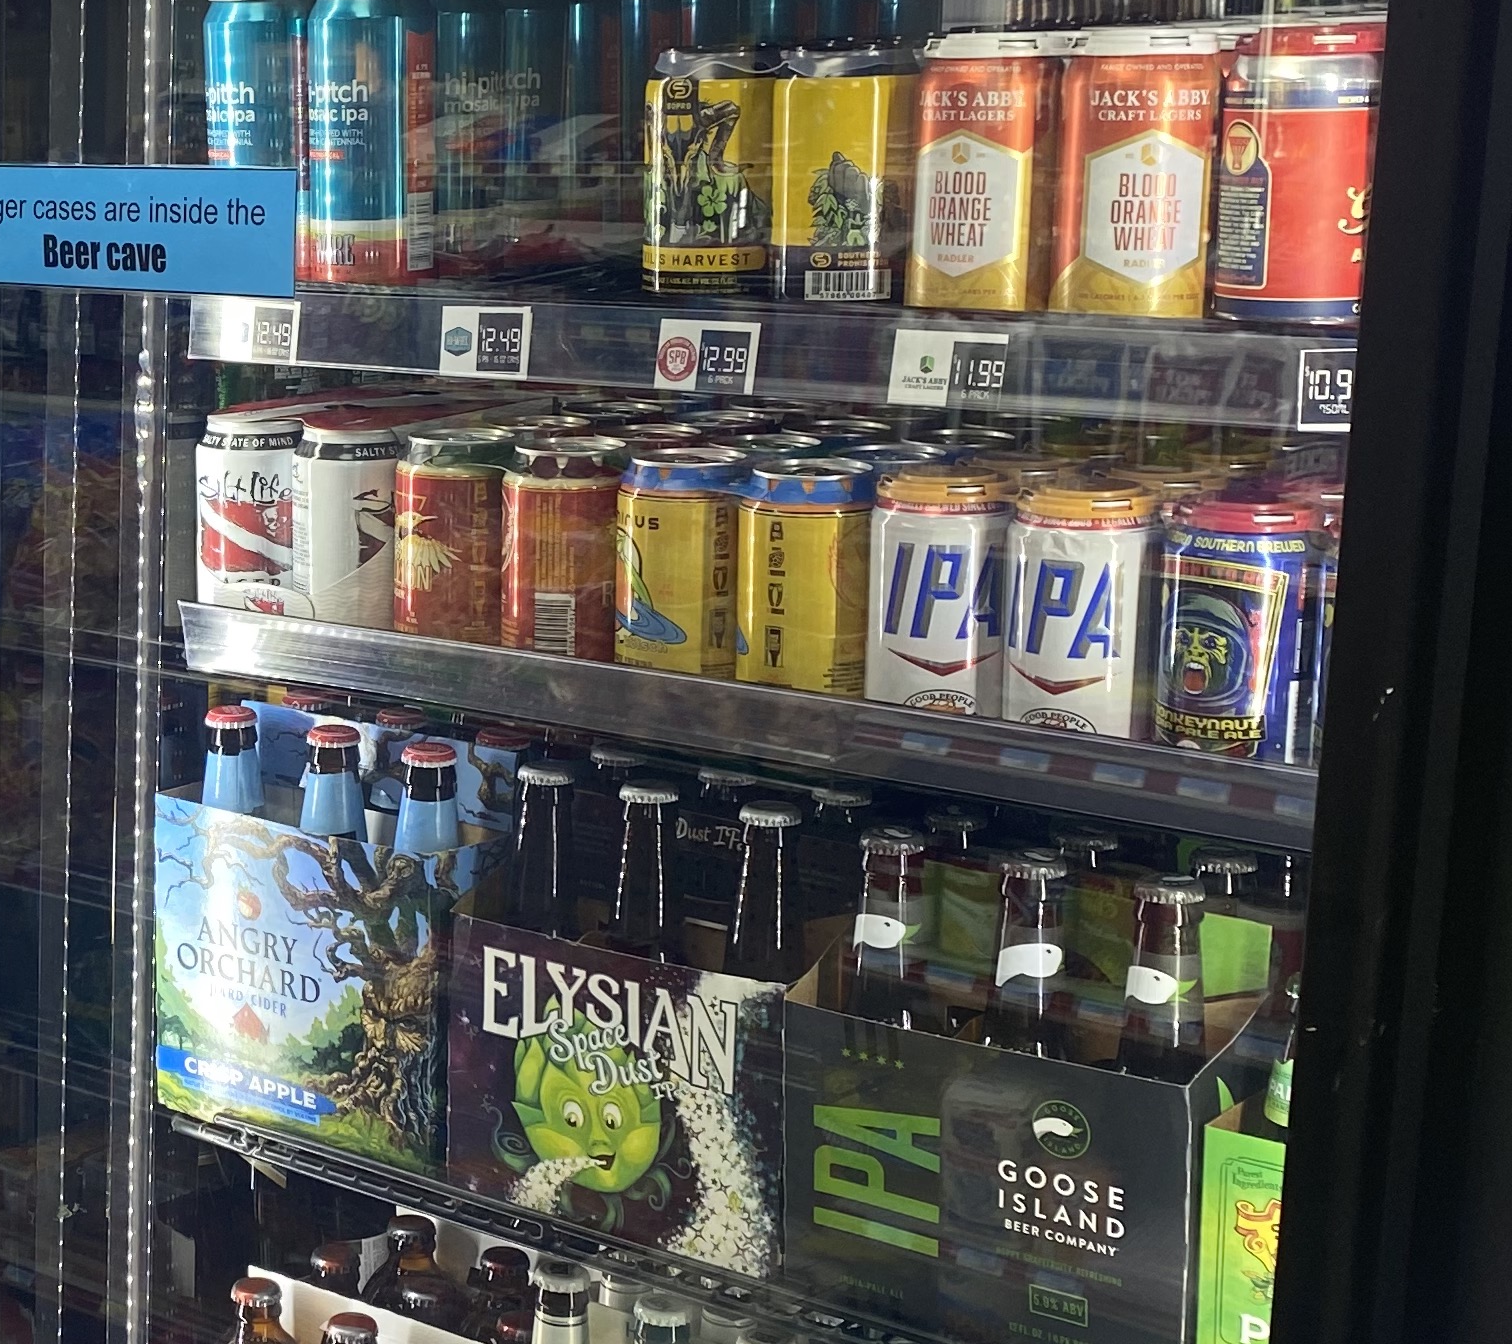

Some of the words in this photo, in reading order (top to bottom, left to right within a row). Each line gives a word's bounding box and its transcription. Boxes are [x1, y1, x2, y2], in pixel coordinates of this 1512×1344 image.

[1090, 89, 1158, 109] JACK'S
[959, 109, 1016, 122] LAGERS
[1098, 109, 1151, 123] CRAFT
[934, 170, 987, 195] BLOOD
[1118, 172, 1178, 198] BLOOD
[33, 198, 97, 223] cases
[104, 201, 141, 223] are
[148, 195, 219, 226] inside
[226, 197, 267, 226] the
[929, 196, 992, 222] ORANGE
[1110, 199, 1182, 225] ORANGE
[930, 222, 989, 249] WHEAT
[1113, 225, 1178, 253] WHEAT
[43, 233, 100, 272] Beer
[106, 239, 167, 274] cave
[672, 252, 752, 267] HARVEST
[668, 349, 688, 365] SPB
[253, 437, 265, 448] OF
[268, 436, 294, 447] MIND
[354, 447, 386, 458] SALTY
[1193, 536, 1255, 554] SOUTHERN
[884, 542, 1002, 640] IPA
[1008, 558, 1126, 660] IPA
[938, 692, 976, 709] PEOPLE
[1052, 711, 1089, 731] PEOPLE
[1176, 722, 1221, 739] PALE
[1224, 728, 1263, 740] ALE
[196, 915, 299, 966] ANGRY
[176, 941, 322, 1004] ORCHARD
[482, 945, 739, 1096] ELYSIAN
[546, 1017, 634, 1071] Space
[587, 1047, 669, 1096] Dust
[248, 1074, 318, 1110] APPLE
[813, 1103, 941, 1258] IPA
[997, 1158, 1126, 1212] GOOSE
[997, 1187, 1126, 1240] ISLAND
[1003, 1217, 1041, 1239] BEER
[1044, 1228, 1118, 1258] COMPANY
